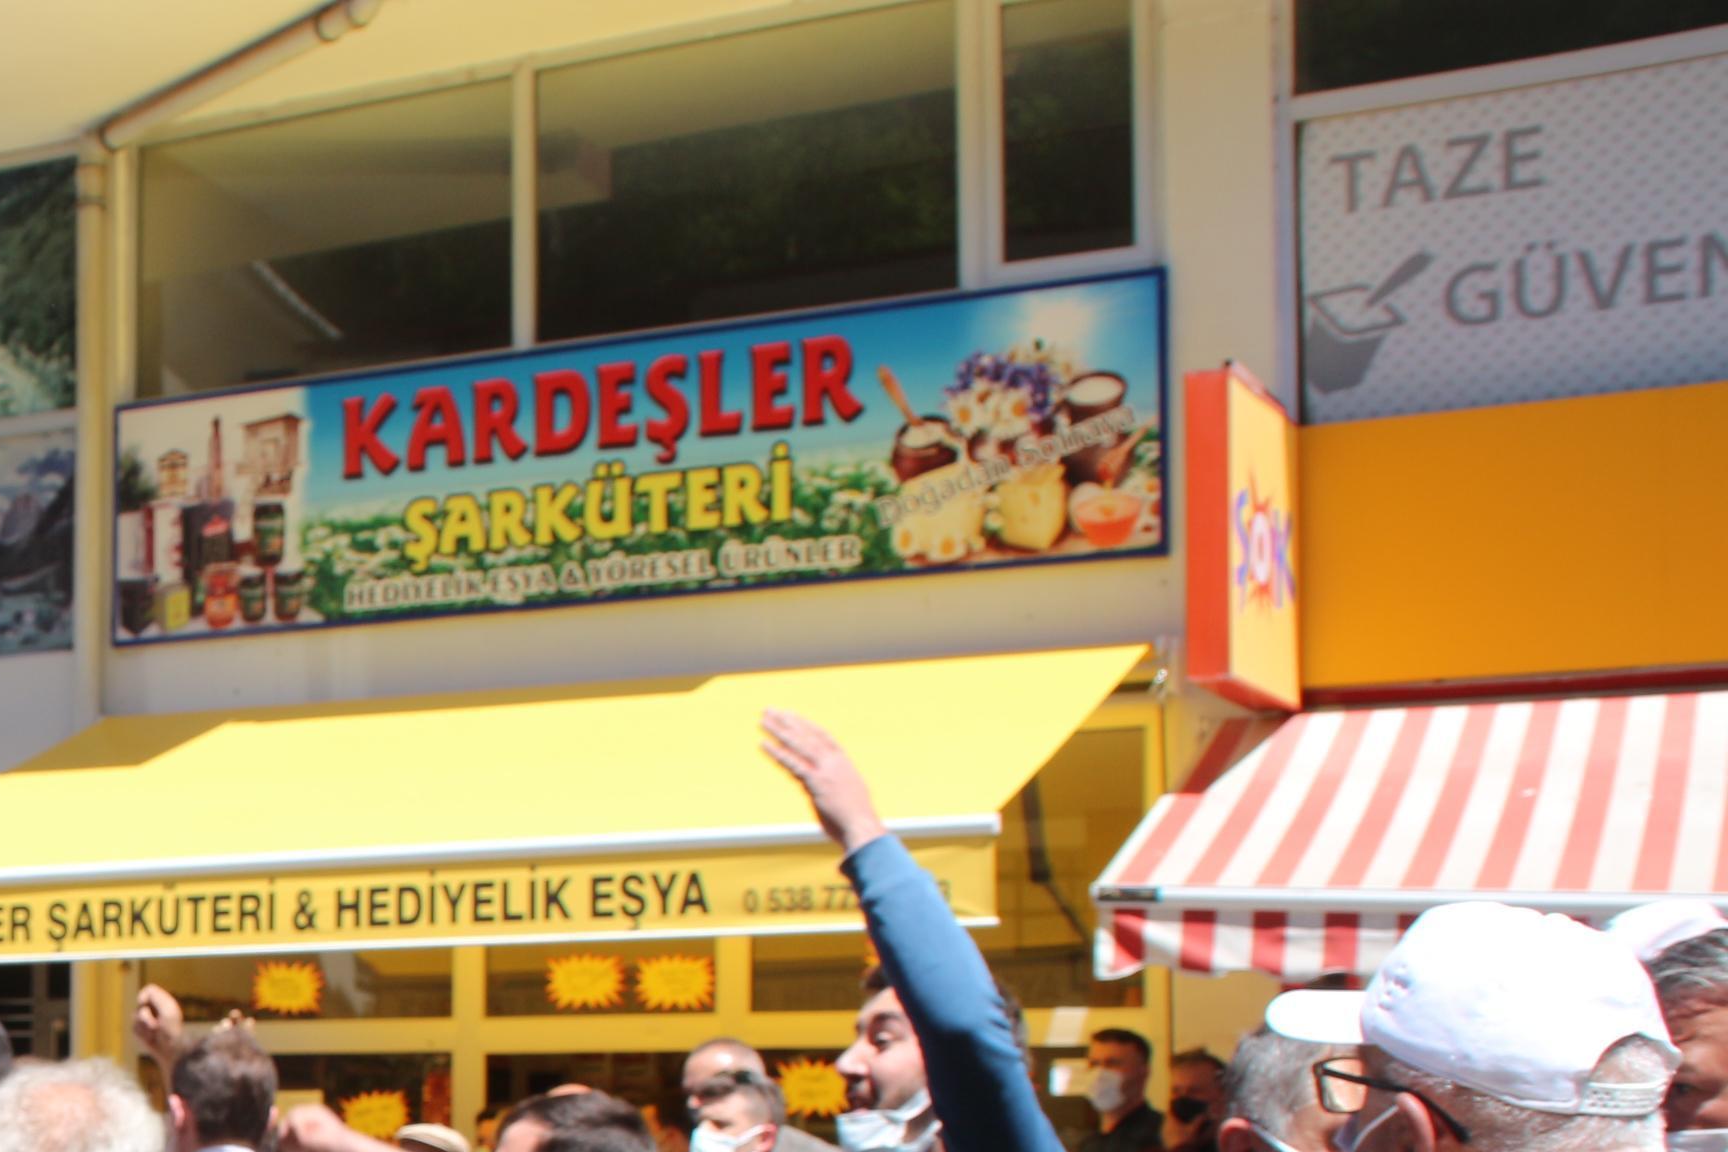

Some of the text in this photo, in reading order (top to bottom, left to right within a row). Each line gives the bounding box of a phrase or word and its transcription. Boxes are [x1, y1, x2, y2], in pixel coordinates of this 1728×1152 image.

[1332, 125, 1546, 214] TAZE
[342, 334, 865, 479] KARDEŞLER
[403, 442, 794, 572] ŞARKÜTERİ
[586, 549, 714, 588] YÖRESEL
[718, 535, 862, 576] ÜRÜNLER
[48, 878, 276, 953] ŞARKÜTERİ
[293, 889, 317, 931] &
[336, 865, 571, 928] HEDİYELİK
[590, 872, 709, 930] EŞYA
